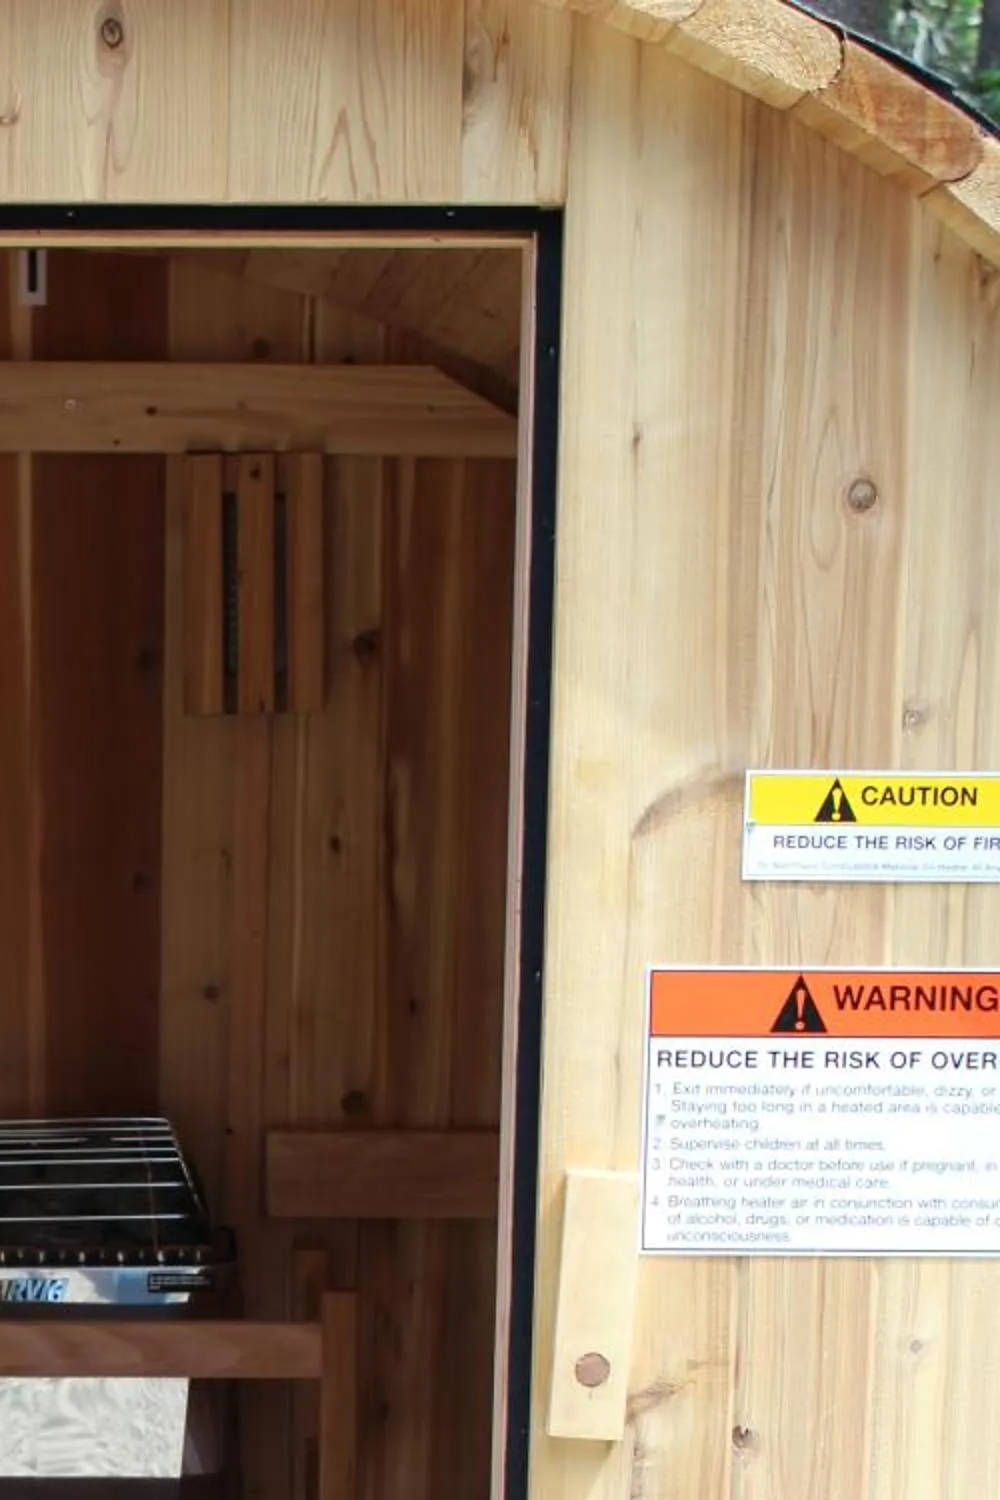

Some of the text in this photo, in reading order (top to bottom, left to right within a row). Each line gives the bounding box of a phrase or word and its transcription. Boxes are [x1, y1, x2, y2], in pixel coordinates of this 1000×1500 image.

[861, 786, 978, 806] CAUTION
[773, 835, 848, 849] REDUCE
[855, 835, 889, 849] THE
[895, 836, 936, 850] RISK
[943, 836, 967, 850] OF
[833, 985, 1000, 1011] WARNING
[657, 1050, 997, 1070] REDUCE THE RISK OF OVER
[673, 1082, 700, 1095] Exit
[705, 1083, 795, 1098] immediately
[981, 1087, 996, 1096] or
[671, 1100, 727, 1114] Staying
[732, 1101, 757, 1113] too
[761, 1101, 794, 1115] long
[800, 1101, 812, 1113] in
[818, 1103, 827, 1113] a
[831, 1101, 883, 1113] heated
[888, 1103, 921, 1114] area
[669, 1137, 740, 1151] Supervise
[744, 1138, 801, 1150] children
[805, 1139, 819, 1151] at
[824, 1139, 840, 1151] all
[669, 1158, 714, 1171] Check
[720, 1159, 749, 1171] with
[753, 1161, 763, 1171] a
[768, 1160, 814, 1171] doctor
[819, 1160, 864, 1172] before
[723, 1178, 739, 1188] or
[744, 1176, 787, 1188] under
[792, 1176, 850, 1188] medical
[667, 1195, 736, 1209] Breathing
[830, 1197, 913, 1210] conjunction
[917, 1198, 947, 1209] with
[668, 1213, 681, 1225] of
[796, 1216, 810, 1225] or
[816, 1214, 893, 1226] medication
[914, 1215, 971, 1227] capable
